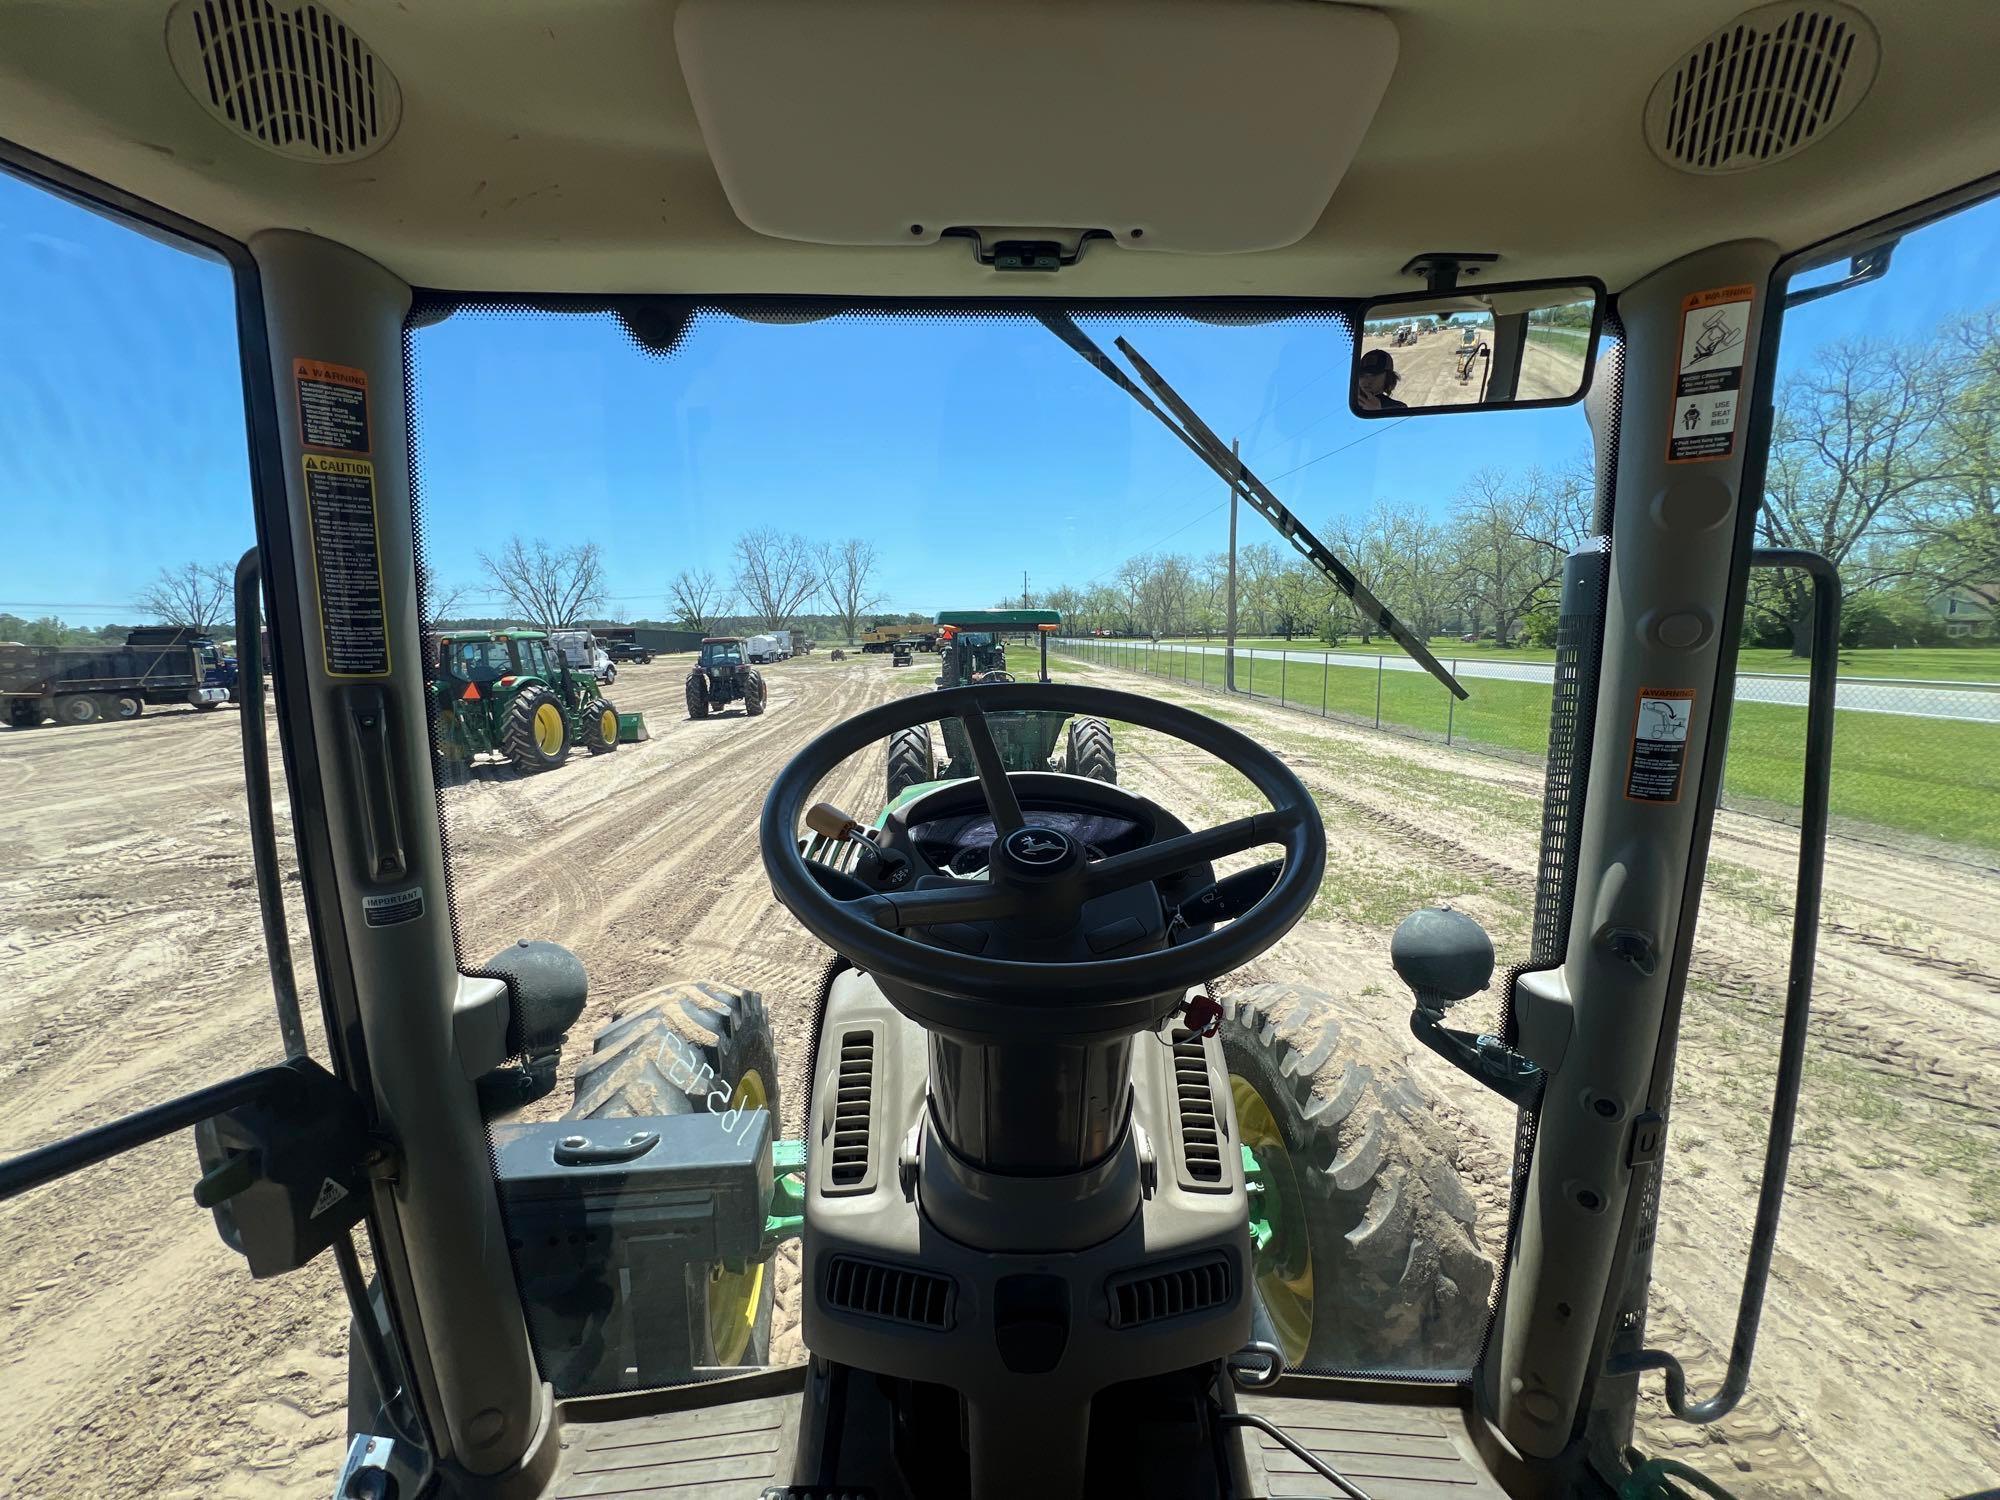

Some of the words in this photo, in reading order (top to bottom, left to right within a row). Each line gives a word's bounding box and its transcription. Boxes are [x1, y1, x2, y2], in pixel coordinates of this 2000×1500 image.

[1705, 287, 1752, 300] WARNING
[313, 367, 365, 385] WARNING
[1715, 401, 1731, 409] USE
[1711, 409, 1731, 418] SEAT
[1710, 418, 1730, 427] BELT
[320, 460, 371, 475] CAUTION
[1649, 689, 1695, 697] WARNING
[367, 891, 417, 907] IMPORTANT
